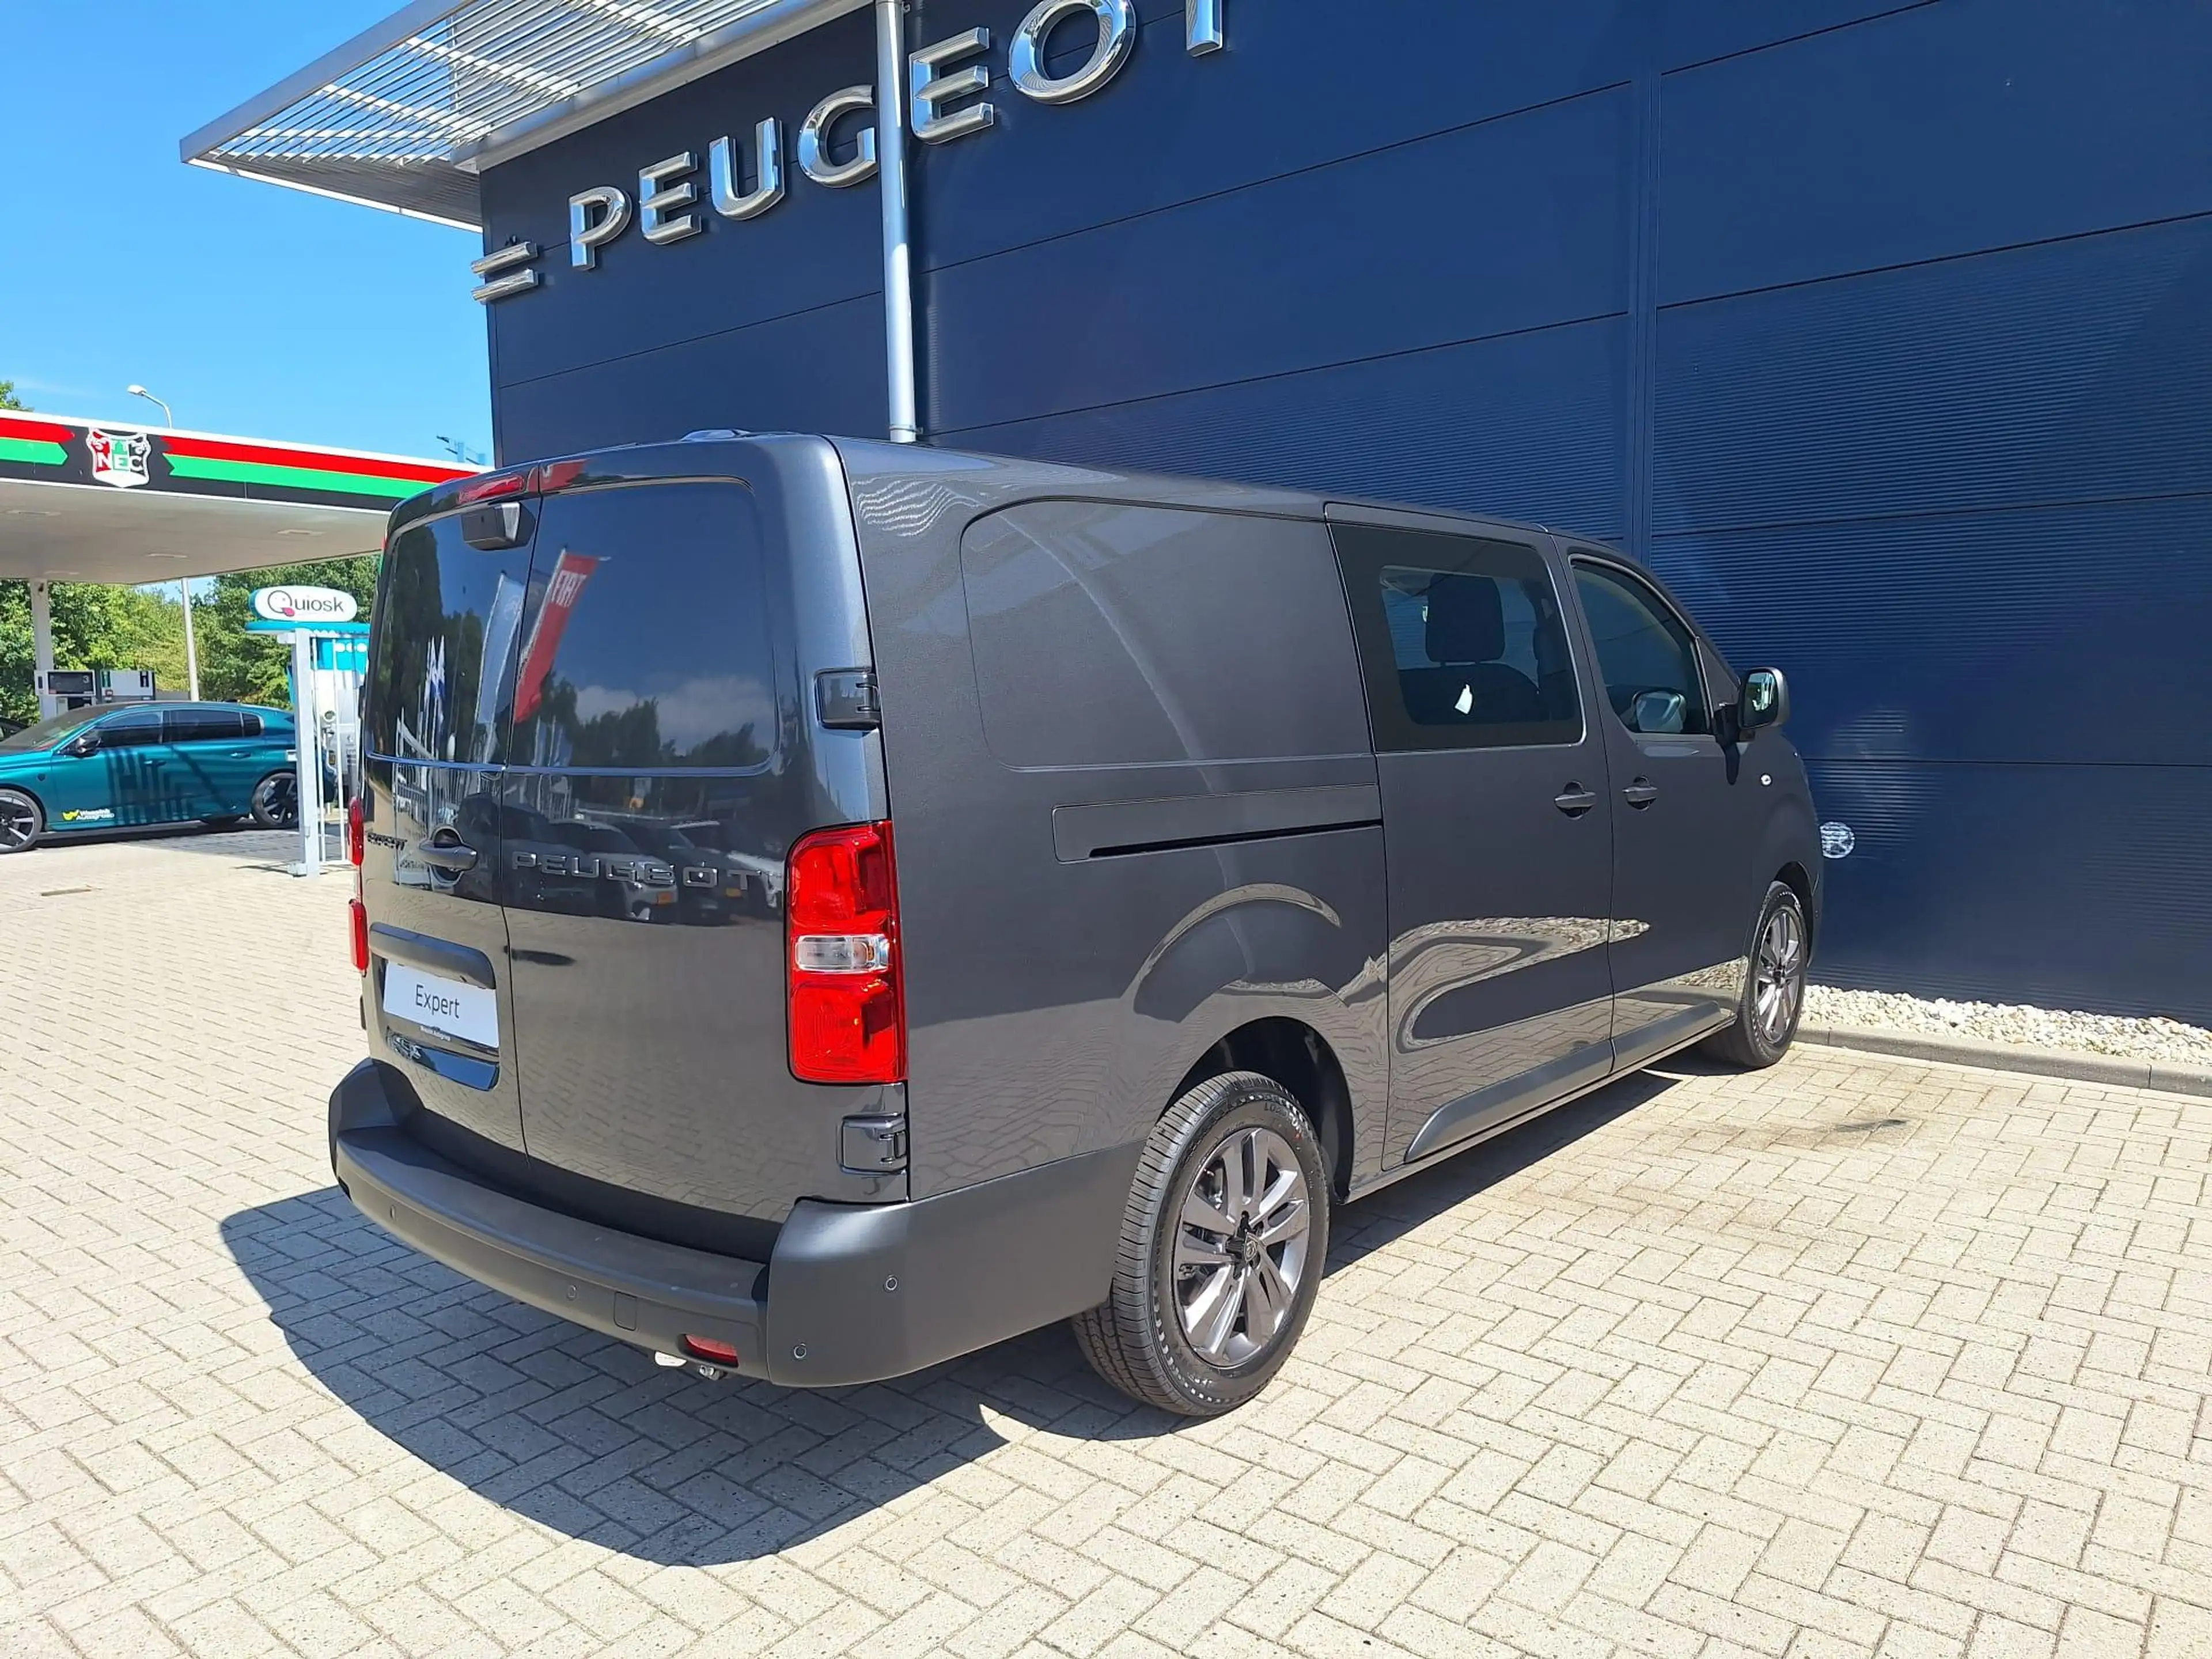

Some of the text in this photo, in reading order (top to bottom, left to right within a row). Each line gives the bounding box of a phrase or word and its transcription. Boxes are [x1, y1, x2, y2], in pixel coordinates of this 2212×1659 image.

[267, 590, 344, 617] Quiosk
[83, 675, 90, 684] 3
[512, 851, 762, 891] PEUGEOT
[415, 984, 460, 1019] Expert
